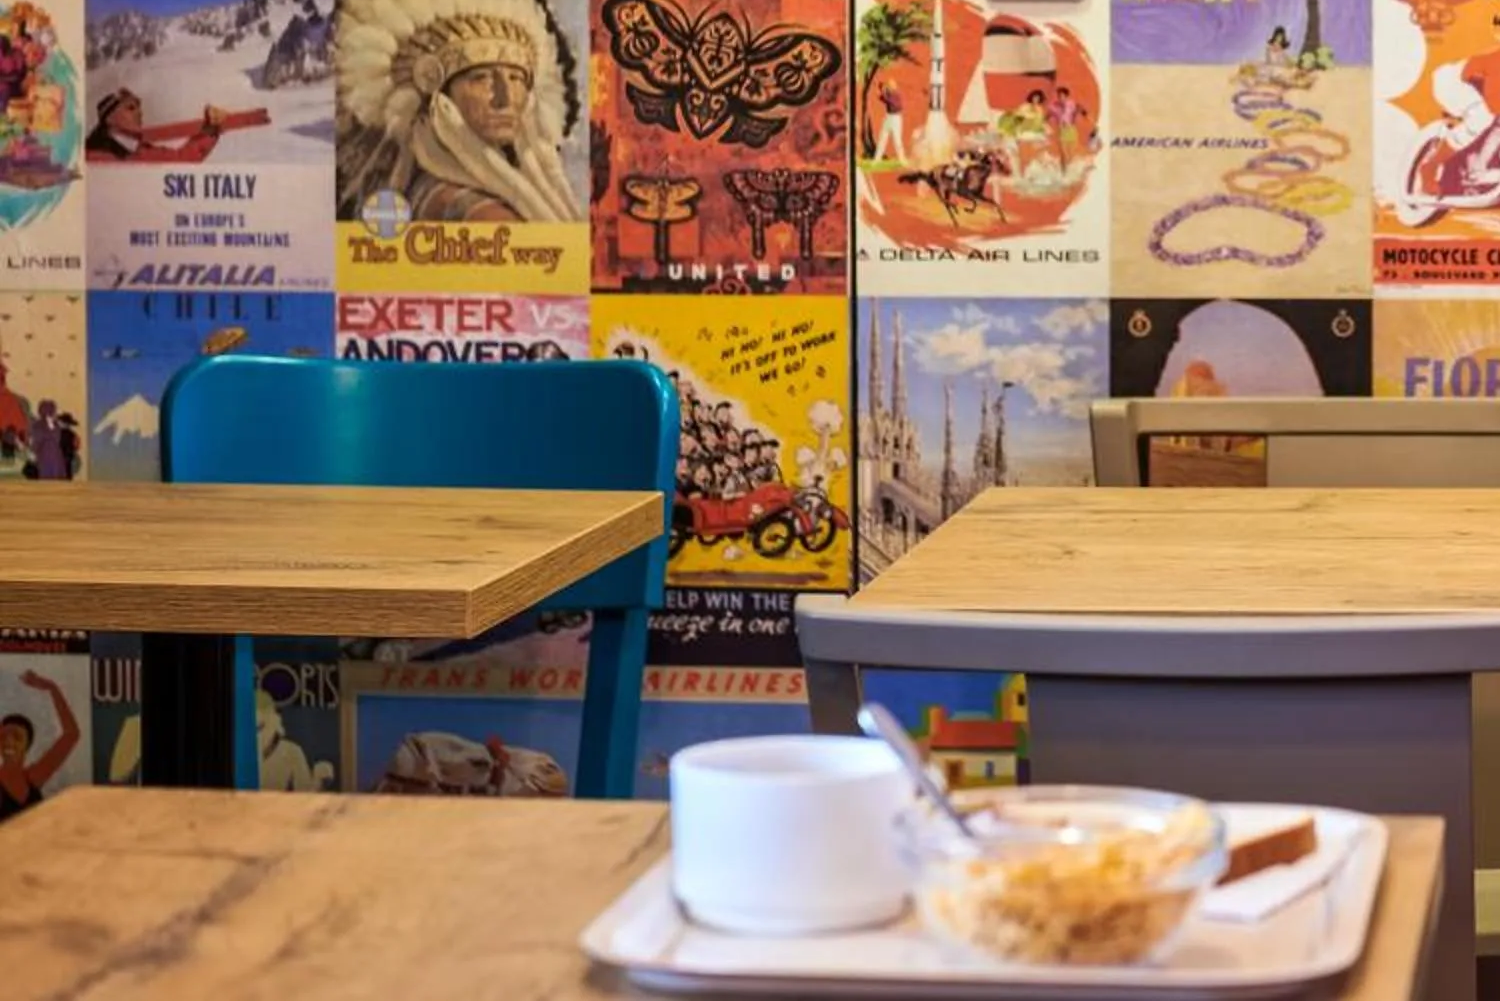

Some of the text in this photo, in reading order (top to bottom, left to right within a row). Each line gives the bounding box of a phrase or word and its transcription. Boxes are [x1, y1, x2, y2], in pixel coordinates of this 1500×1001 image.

[1111, 137, 1269, 150] AMERICAN AIRLINES
[163, 173, 256, 199] SKI ITALY
[129, 232, 290, 248] MOST EXCITING MOUNTAINS
[349, 223, 565, 274] The Chief way
[6, 255, 82, 269] LINES
[879, 247, 1101, 263] DELTA AIR LINES
[1383, 248, 1478, 266] MOTOCYCLE
[128, 263, 276, 286] ALITALIA
[668, 265, 796, 282] UNITED
[339, 298, 516, 332] EXETER
[705, 590, 791, 610] WIN THE
[718, 611, 745, 634] in
[379, 666, 803, 695] TRANS WOR AIRLINES
